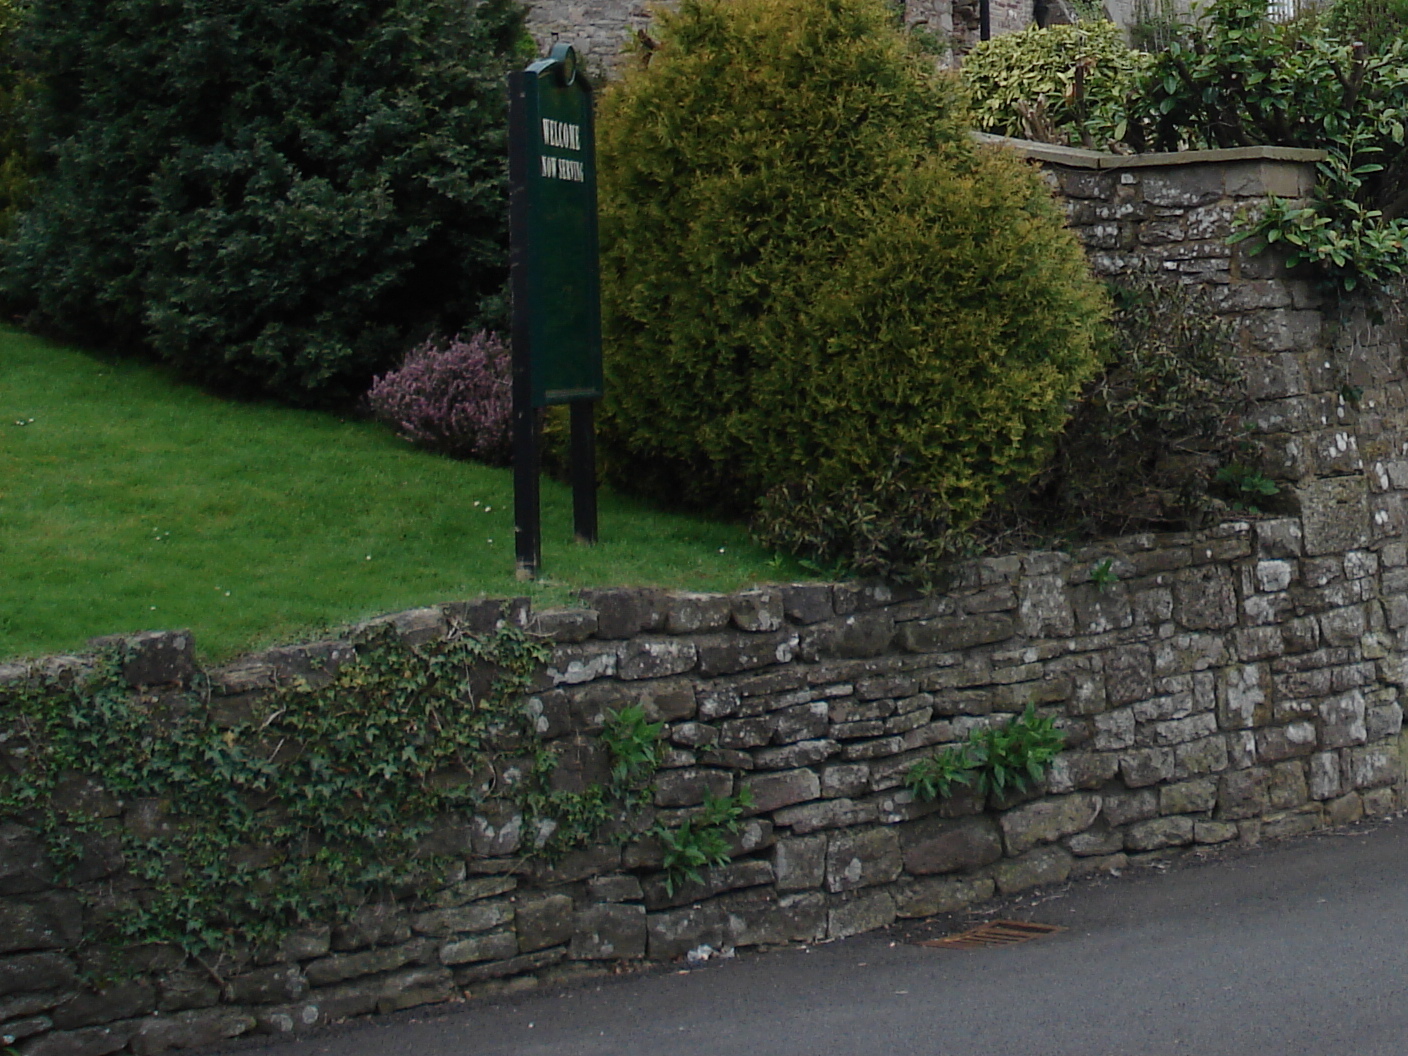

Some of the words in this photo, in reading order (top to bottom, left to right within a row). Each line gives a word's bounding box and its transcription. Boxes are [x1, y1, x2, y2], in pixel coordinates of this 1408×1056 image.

[542, 118, 580, 150] WELCOME
[542, 155, 556, 178] NOW
[558, 158, 583, 182] SERVING
